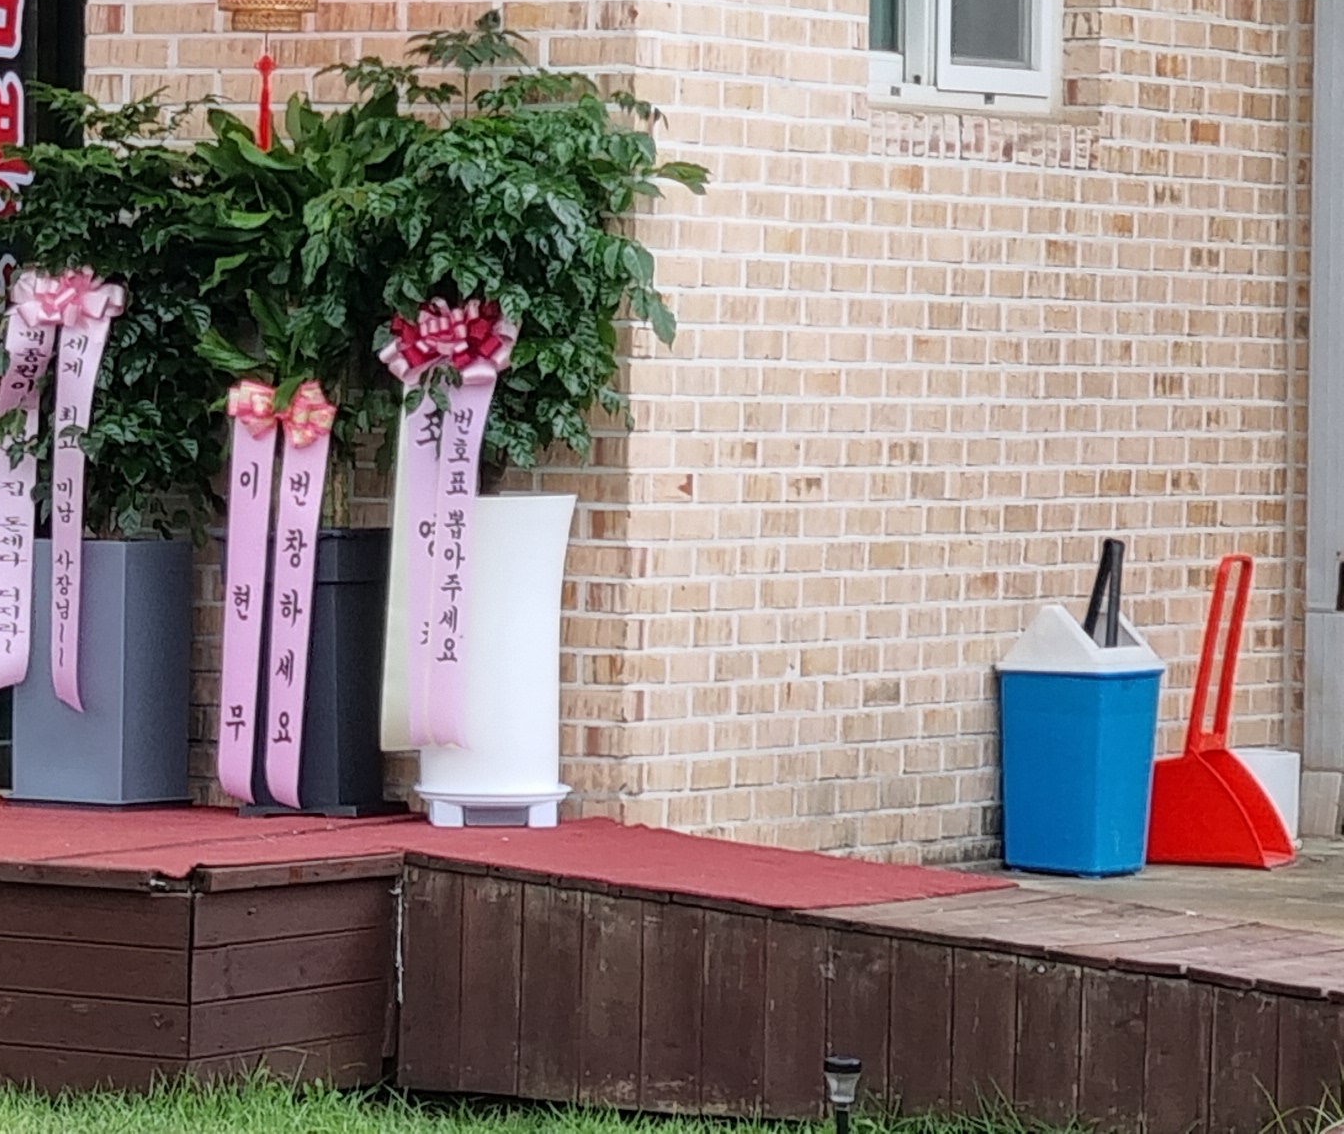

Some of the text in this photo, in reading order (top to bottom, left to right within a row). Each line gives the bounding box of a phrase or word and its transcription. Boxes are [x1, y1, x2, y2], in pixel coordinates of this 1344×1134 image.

[62, 335, 89, 379] 세계
[56, 477, 75, 524] 미남
[225, 461, 260, 741] 이현무
[272, 469, 310, 746] 번창하세요
[436, 407, 473, 664] 번호표 뽑아주세요
